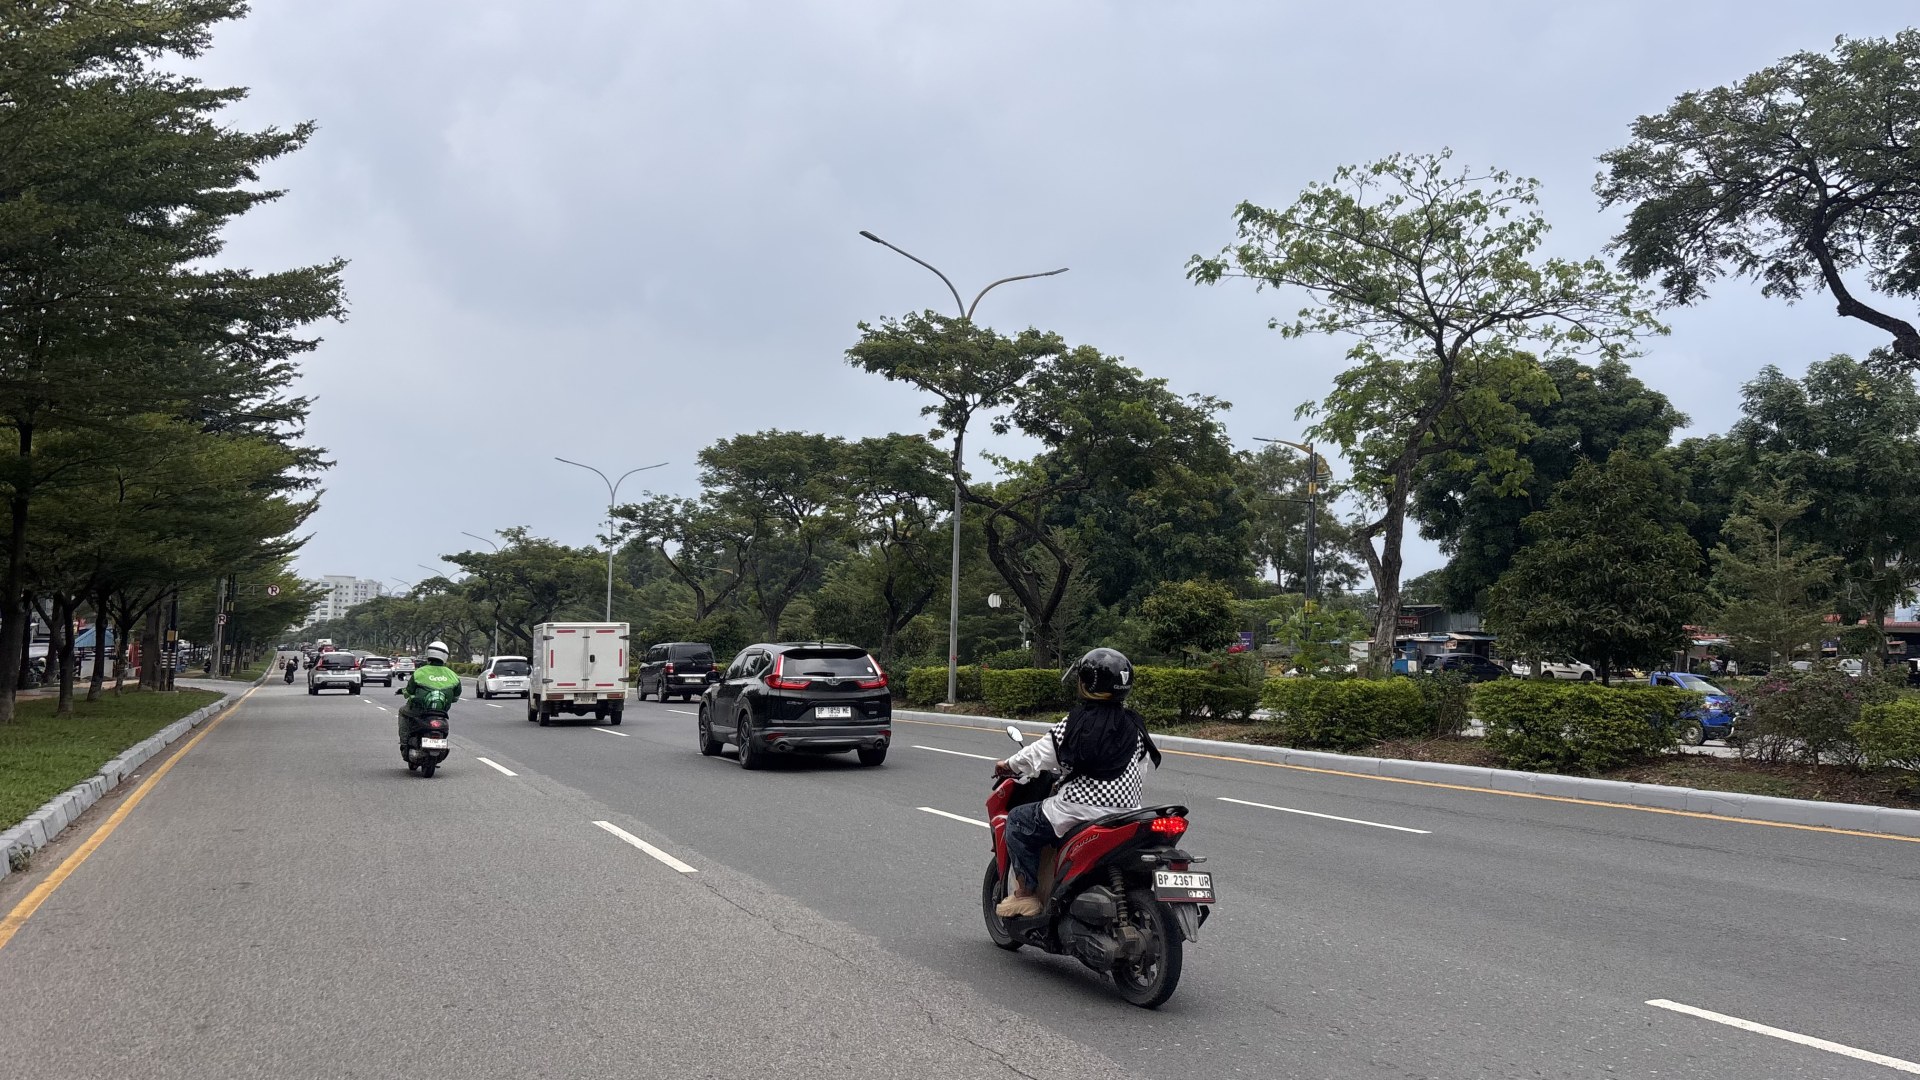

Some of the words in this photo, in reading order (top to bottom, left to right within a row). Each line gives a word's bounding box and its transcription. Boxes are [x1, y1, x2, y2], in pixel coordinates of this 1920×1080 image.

[1158, 874, 1168, 885] BP
[1174, 874, 1193, 886] 2367
[1198, 876, 1210, 887] UR
